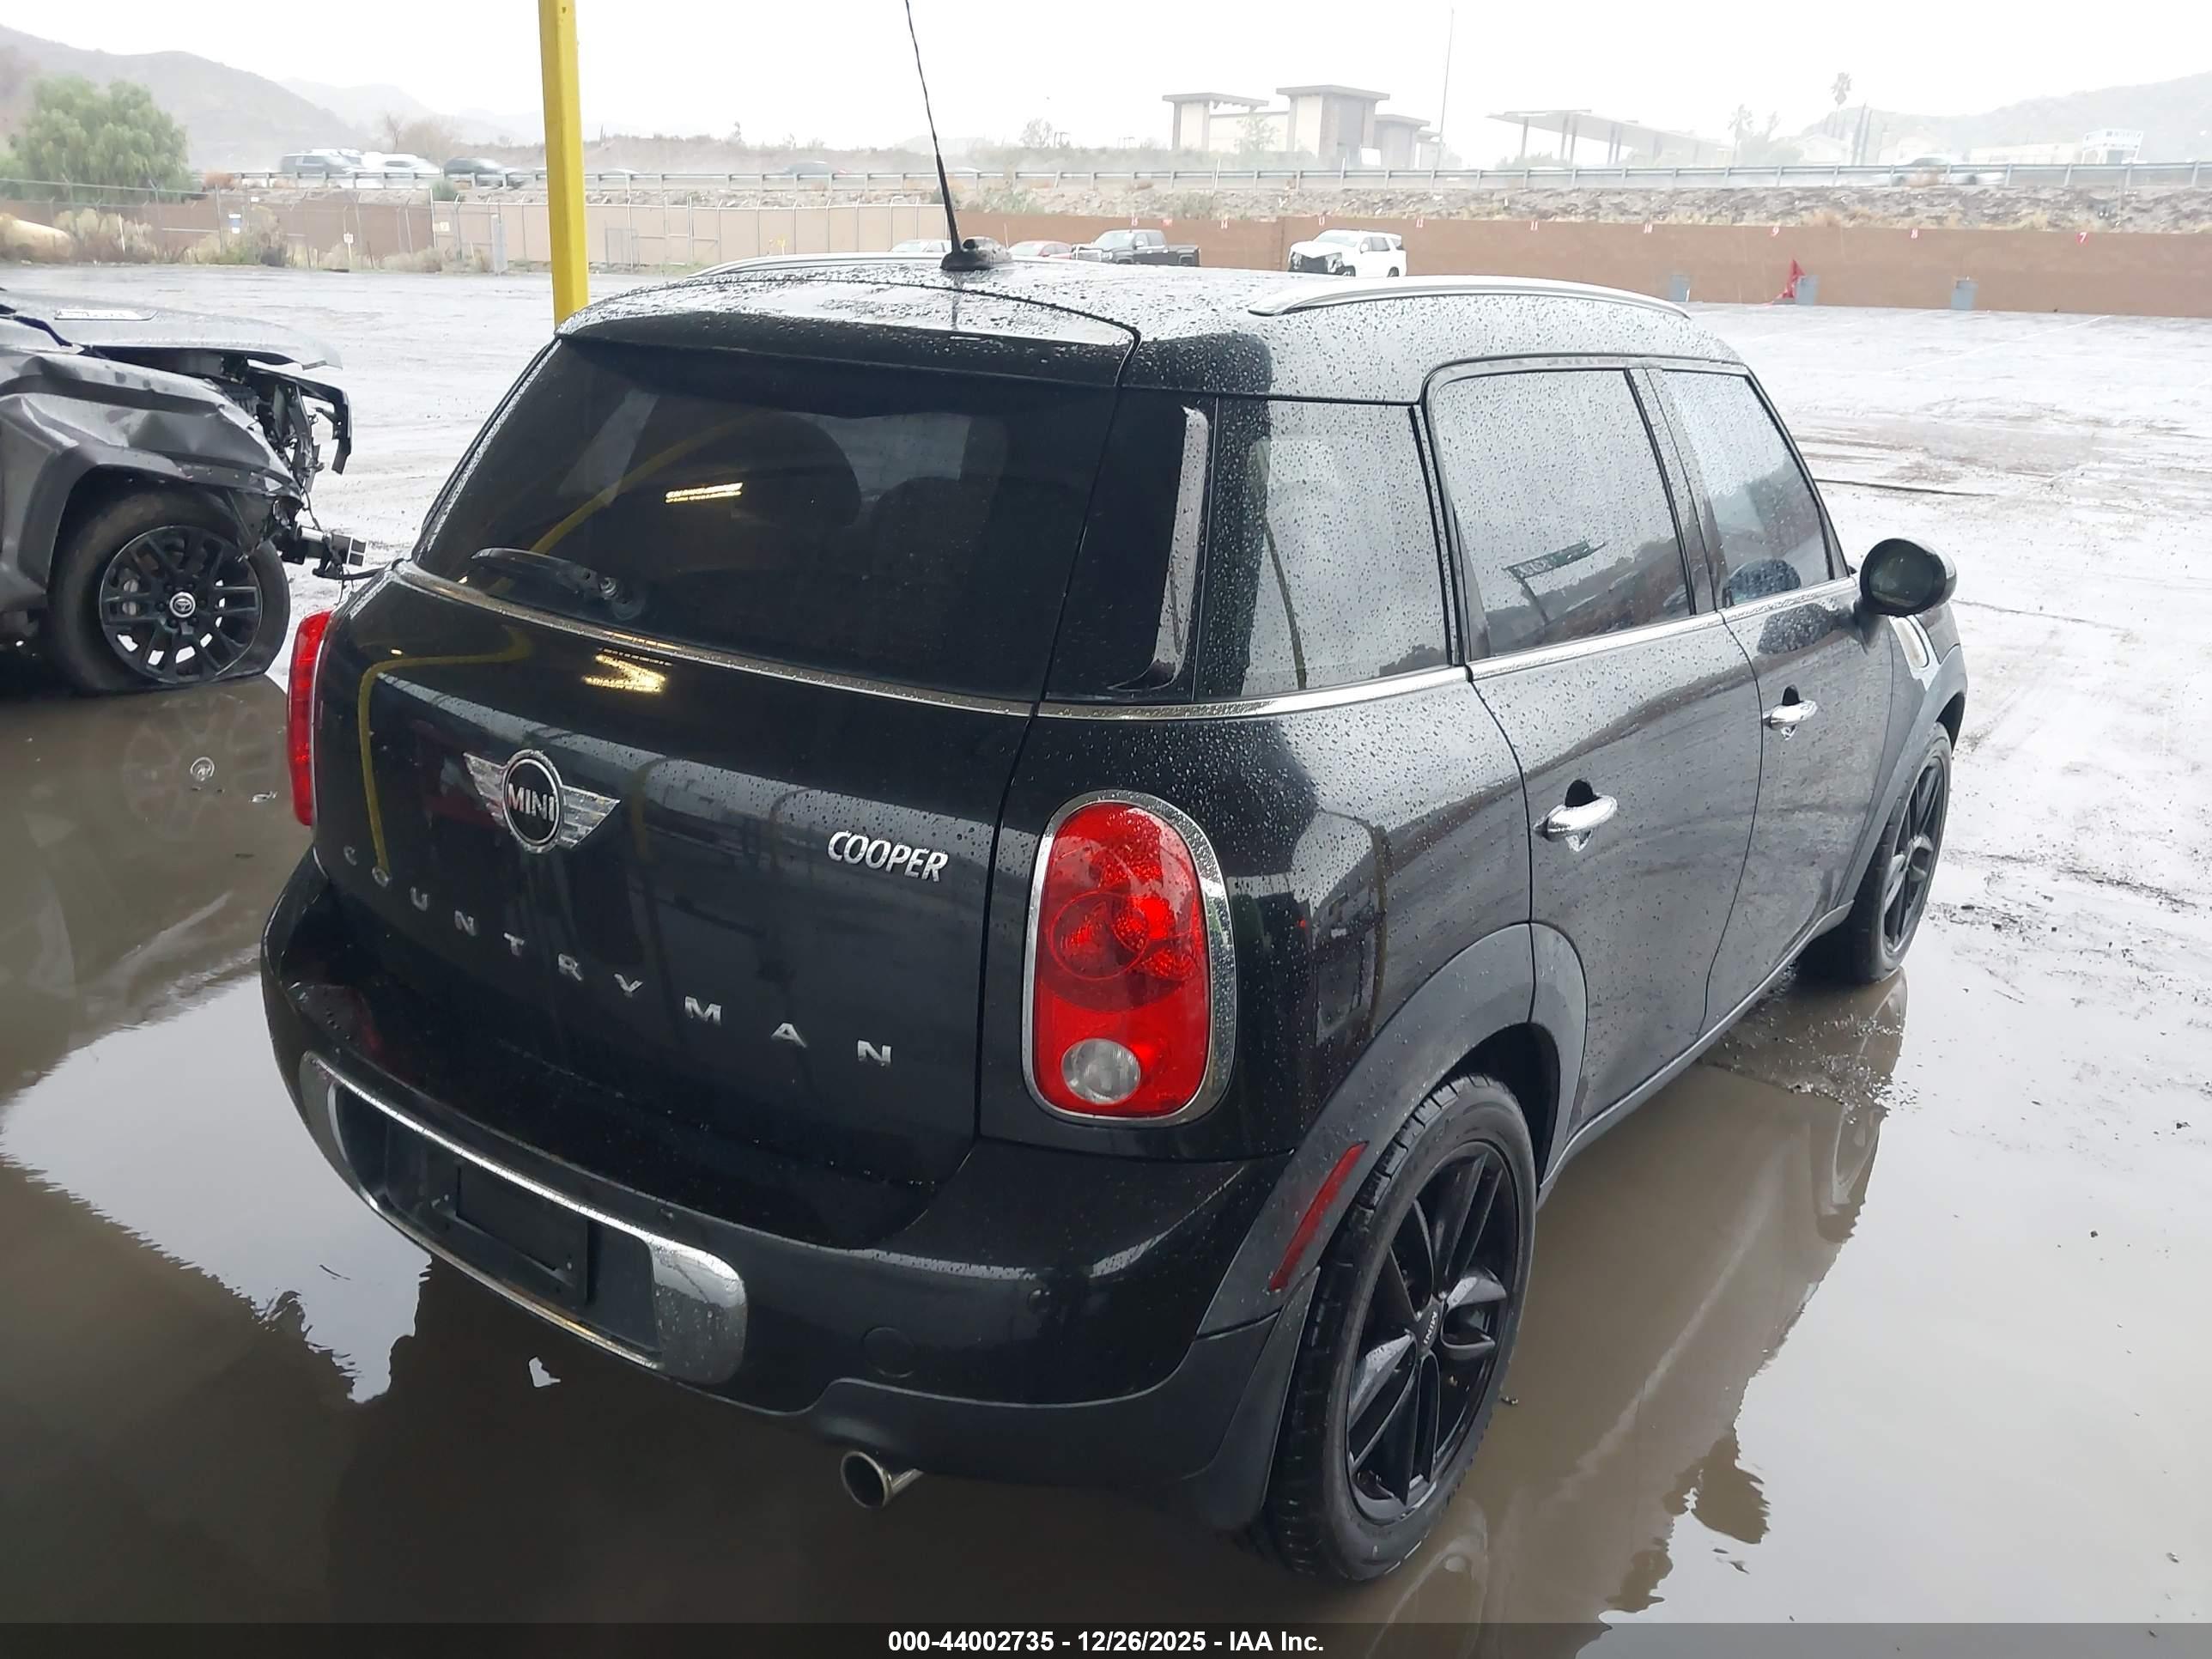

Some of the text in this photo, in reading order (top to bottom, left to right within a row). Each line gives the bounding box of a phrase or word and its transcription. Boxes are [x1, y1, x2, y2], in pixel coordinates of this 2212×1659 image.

[508, 782, 555, 822] MINI
[828, 830, 949, 883] COOPER
[343, 845, 893, 1067] COUNTRYMAN
[1423, 1310, 1437, 1345] MINI
